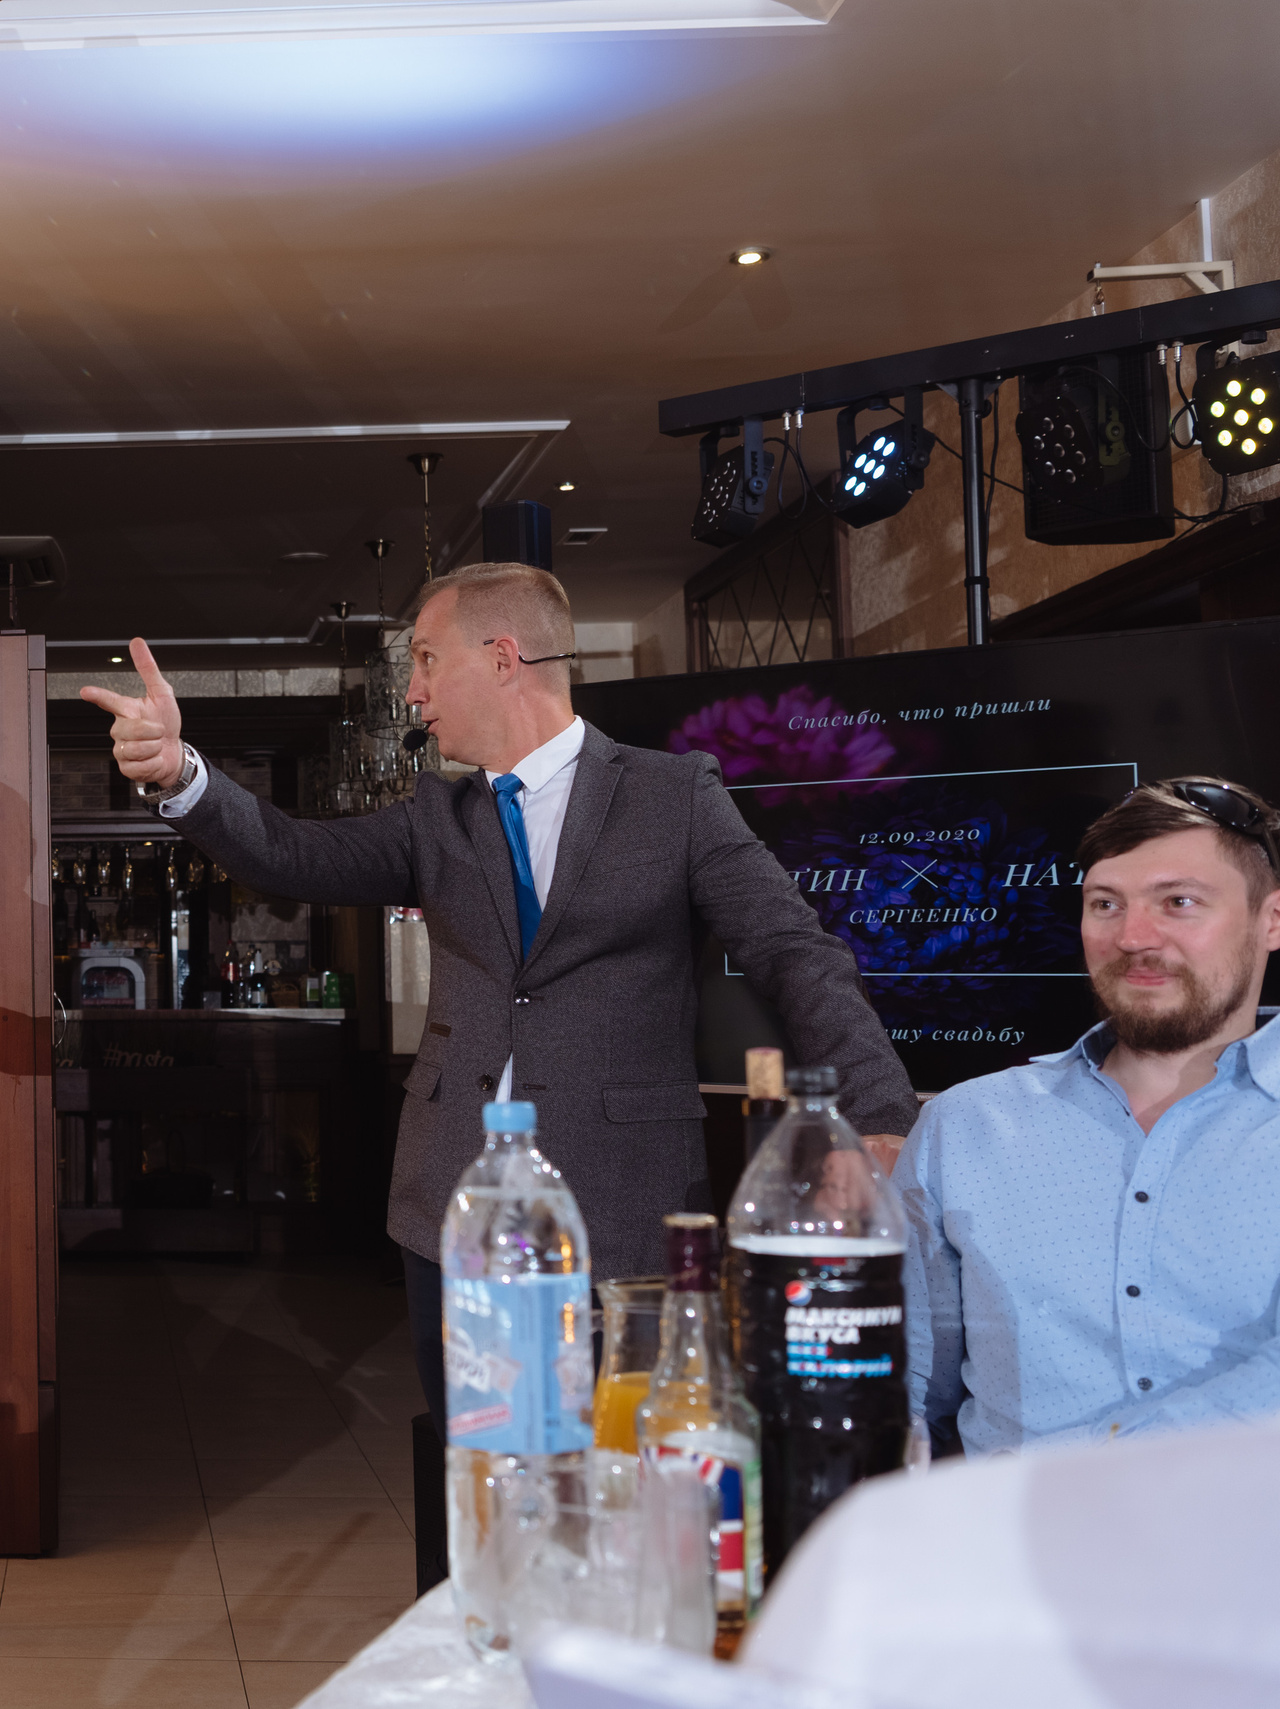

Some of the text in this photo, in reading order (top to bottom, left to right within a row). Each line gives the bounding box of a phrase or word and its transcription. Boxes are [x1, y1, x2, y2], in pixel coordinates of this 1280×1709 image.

[788, 698, 1051, 730] Спасибо, что пришли
[858, 828, 981, 846] 12.09.2020
[849, 906, 998, 924] СЕРГЕЕНКО
[885, 1025, 1025, 1046] шу свадьбу
